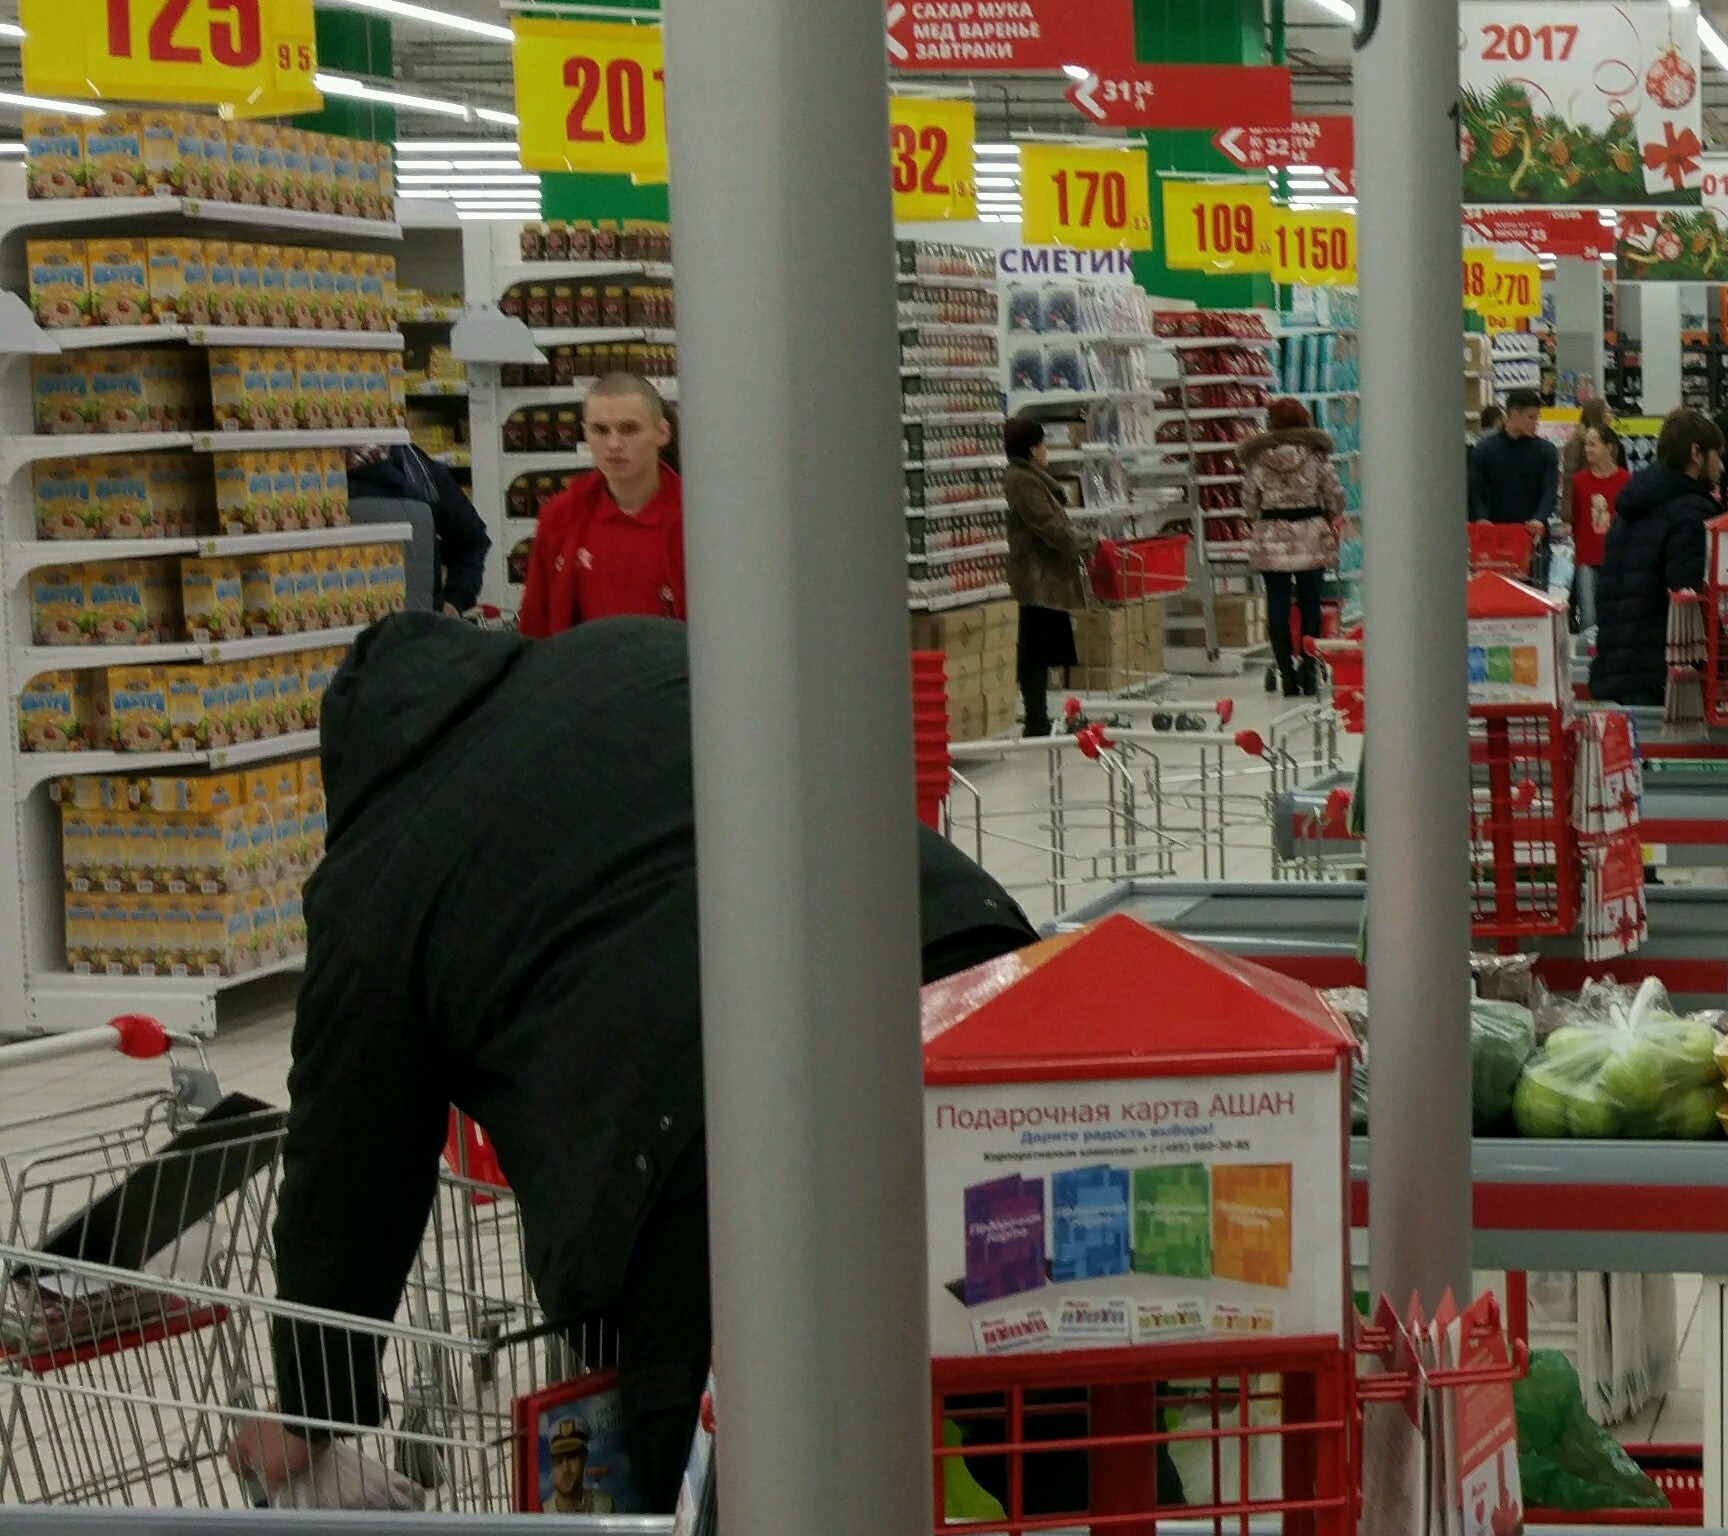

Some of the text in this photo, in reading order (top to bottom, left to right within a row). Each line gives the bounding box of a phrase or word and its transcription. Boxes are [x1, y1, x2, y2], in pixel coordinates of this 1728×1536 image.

[912, 0, 1034, 20] САХАР МУКА
[913, 22, 1041, 43] МЕД ВАРЕНЬЕ
[914, 42, 1014, 60] ЗАВТРАКИ
[1481, 23, 1579, 62] 2017
[1103, 79, 1131, 102] 31
[1051, 168, 1127, 229] 170
[1192, 203, 1254, 255] 109
[1275, 225, 1348, 271] 1150
[936, 1091, 1296, 1133] Подарочная карта АШАН
